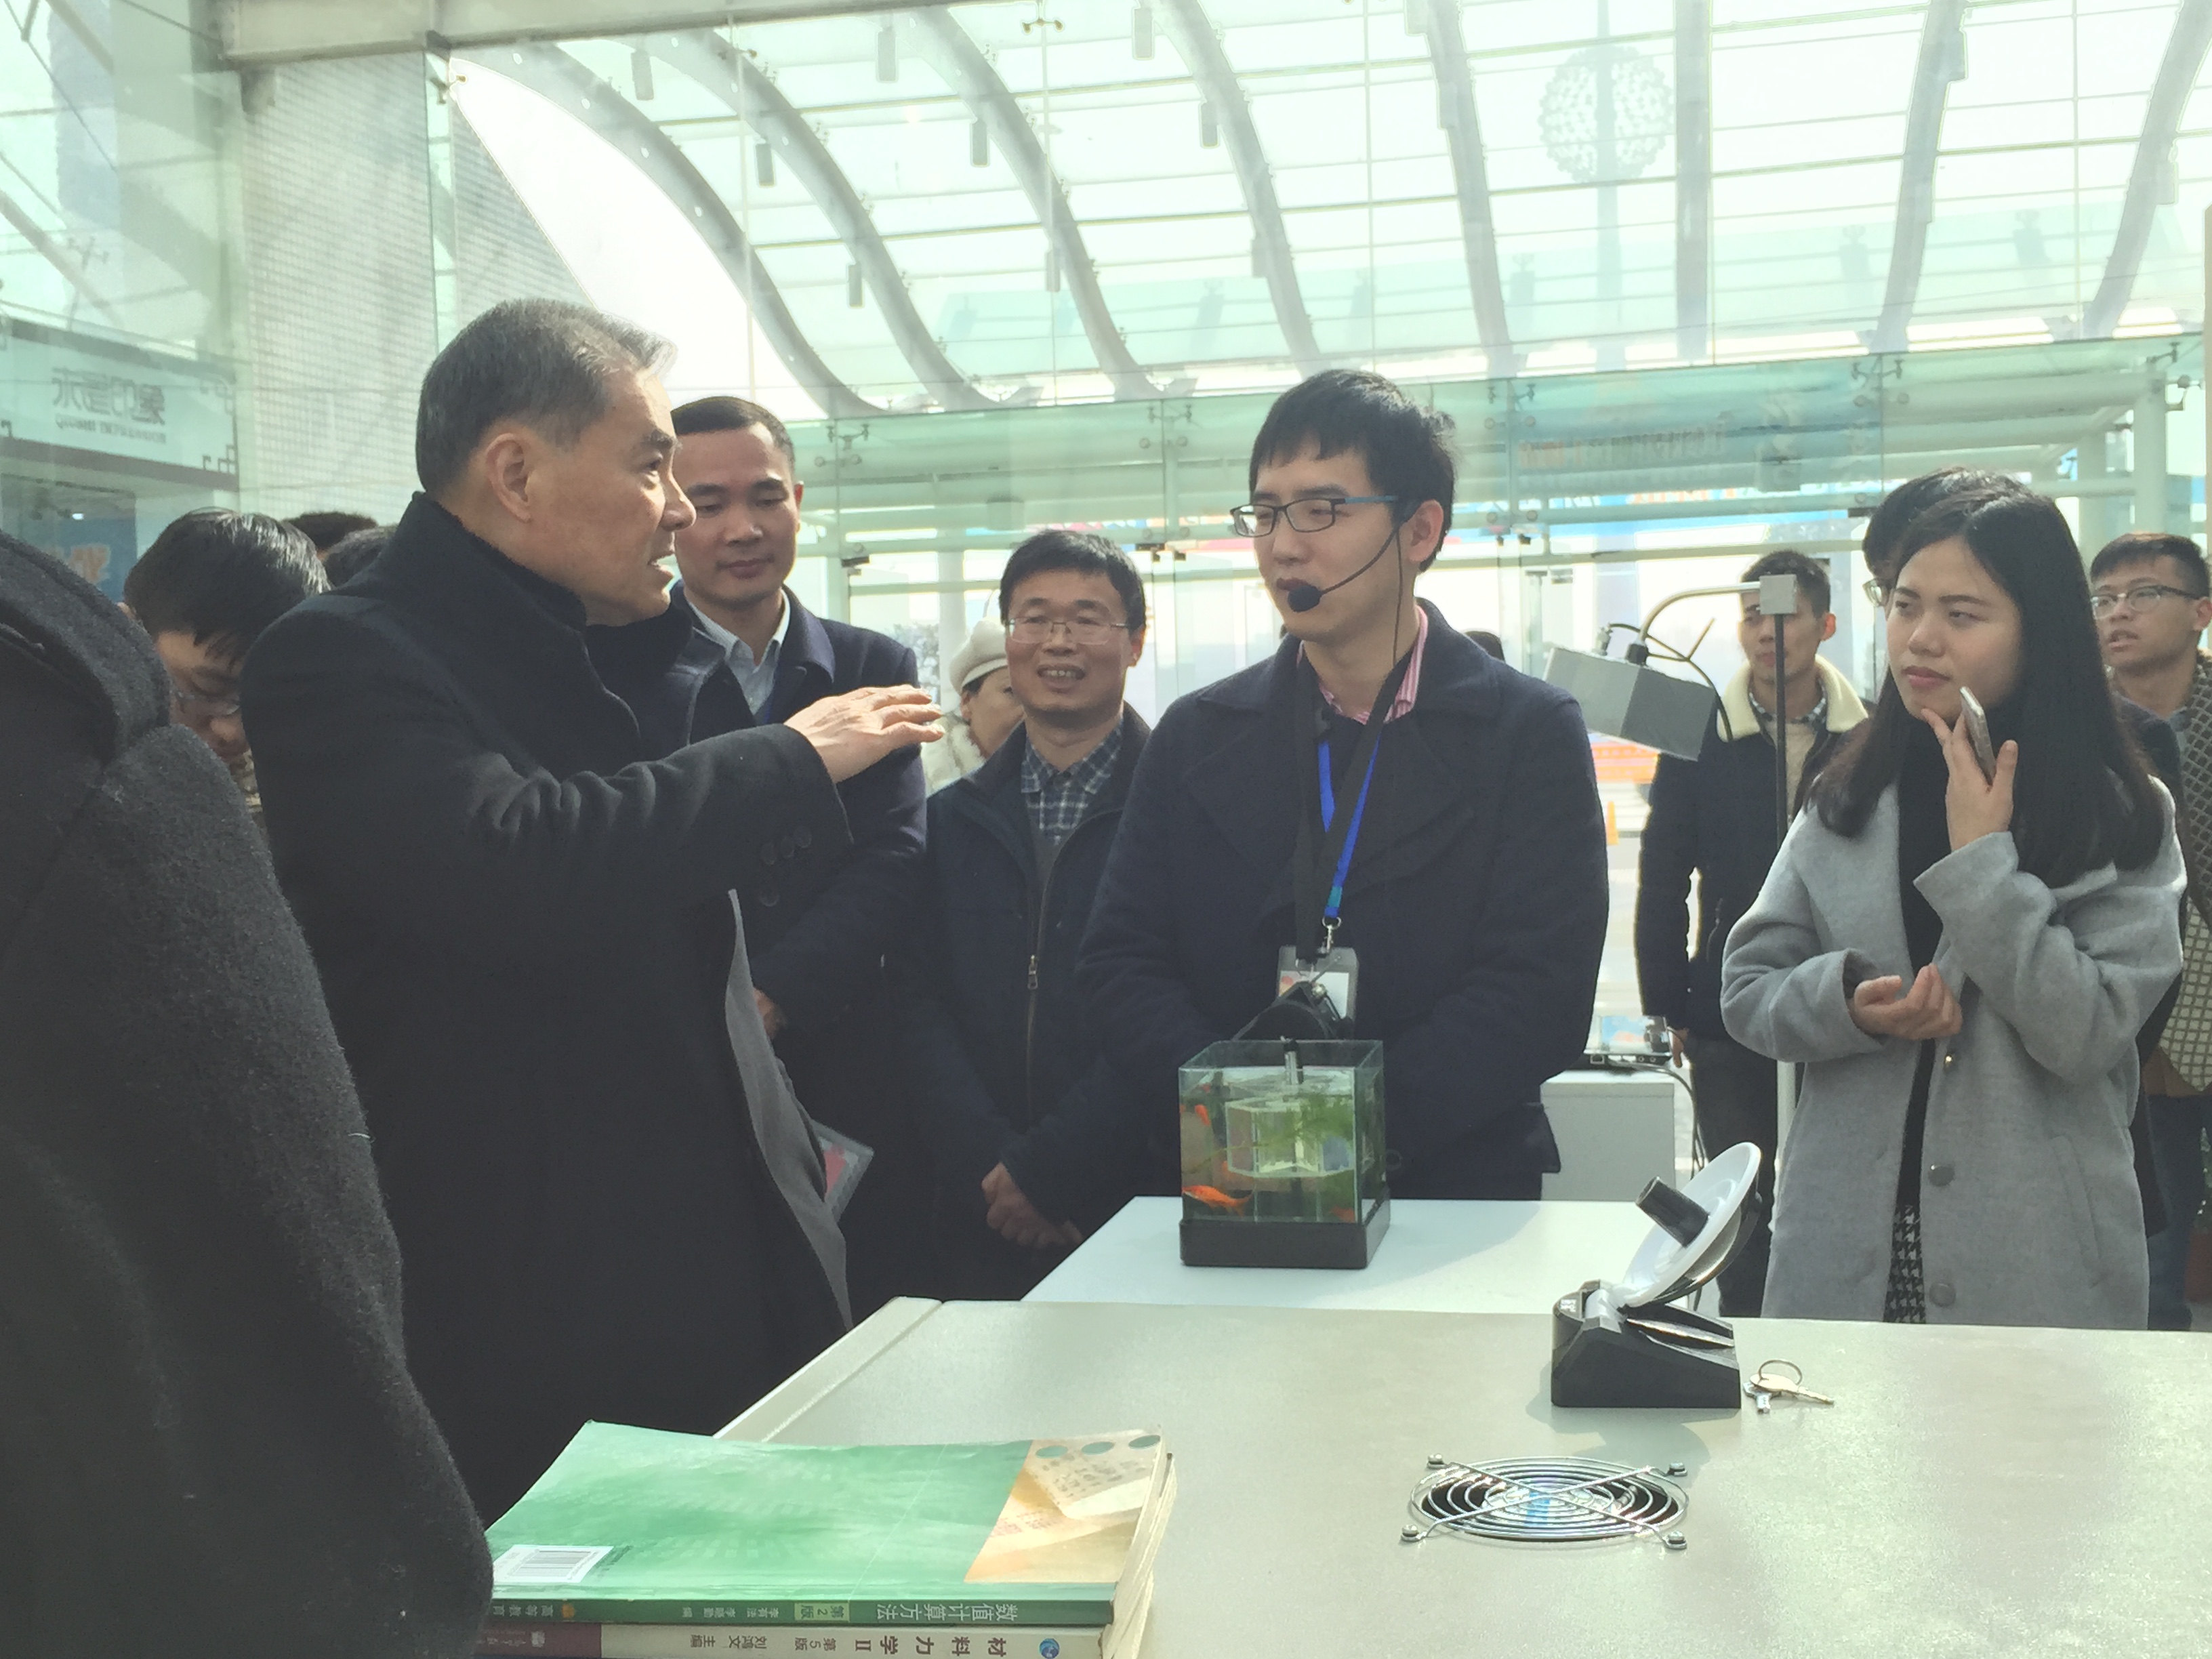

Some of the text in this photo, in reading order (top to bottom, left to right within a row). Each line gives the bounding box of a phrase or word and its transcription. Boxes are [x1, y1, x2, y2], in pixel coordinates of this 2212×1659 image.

[493, 1604, 554, 1618] 高等教育
[747, 1606, 779, 1619] 李有法
[800, 1605, 844, 1620] 第2版
[877, 1603, 1018, 1622] 数值计算方法
[690, 1633, 716, 1649] 主编
[729, 1634, 767, 1650] 刘鸿文
[794, 1636, 836, 1652] 第5版
